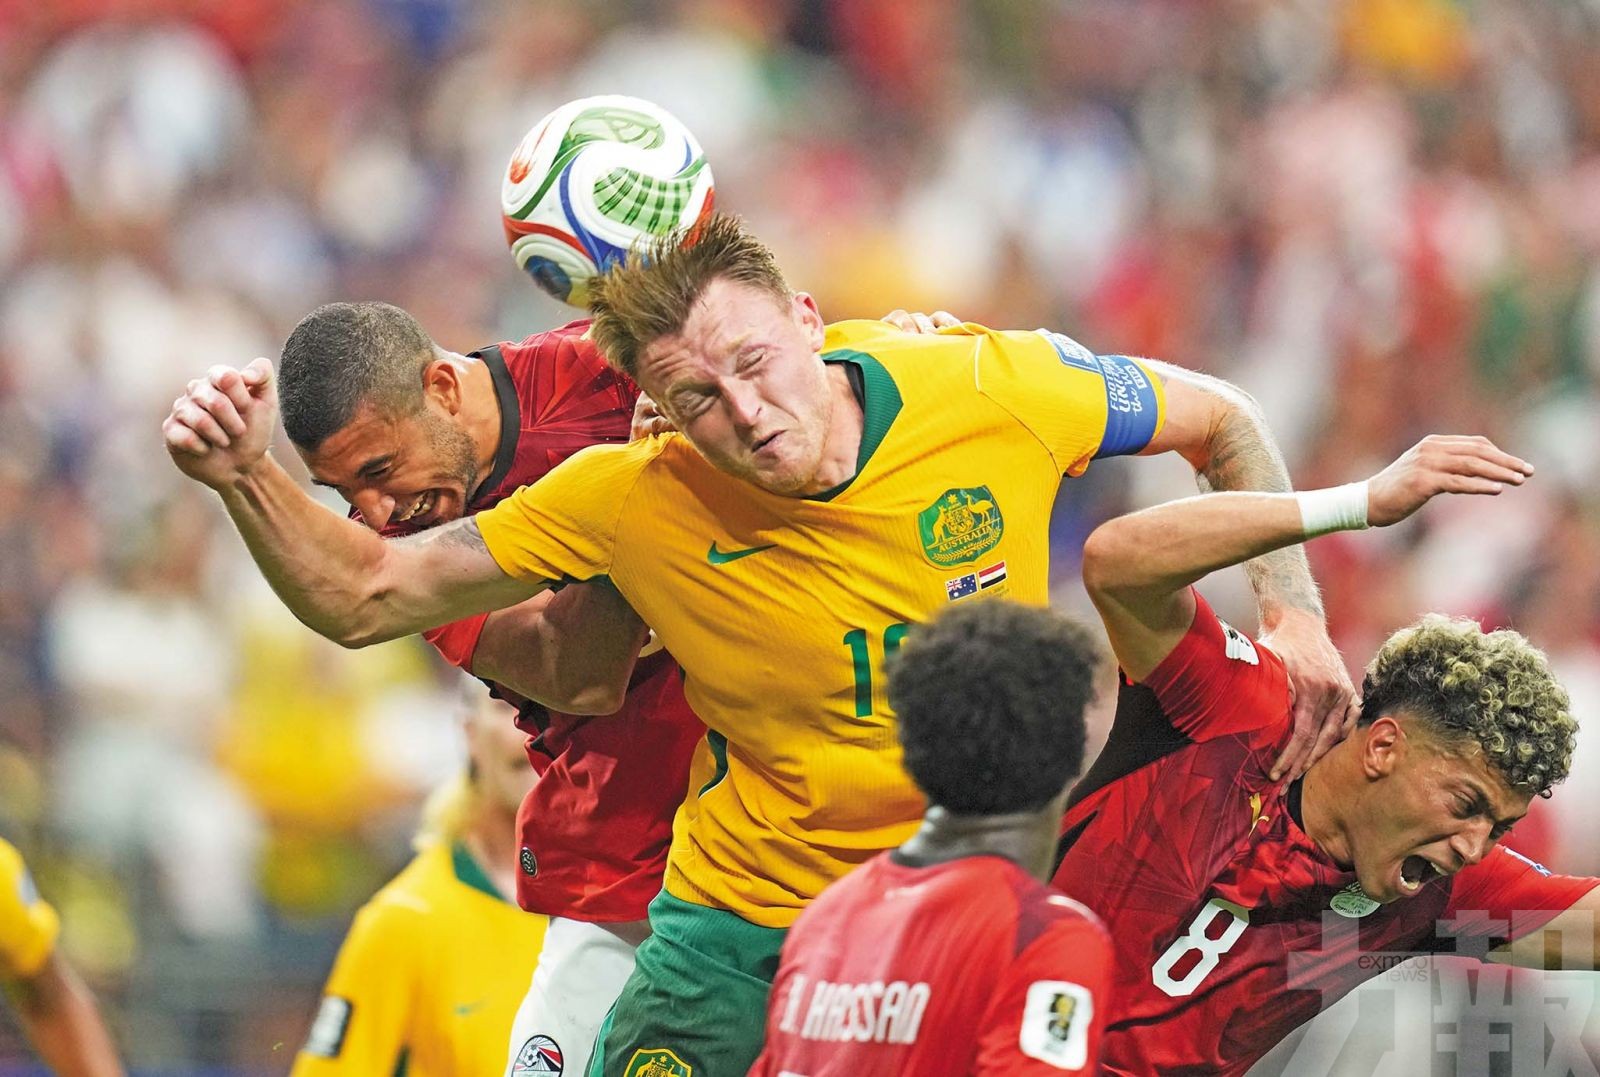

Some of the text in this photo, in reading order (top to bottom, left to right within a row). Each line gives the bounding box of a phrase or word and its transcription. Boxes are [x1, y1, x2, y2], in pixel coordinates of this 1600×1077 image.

[1130, 386, 1143, 416] the
[939, 525, 994, 552] AUSTRALIA
[1152, 898, 1250, 997] 8
[800, 980, 931, 1044] HASSAN
